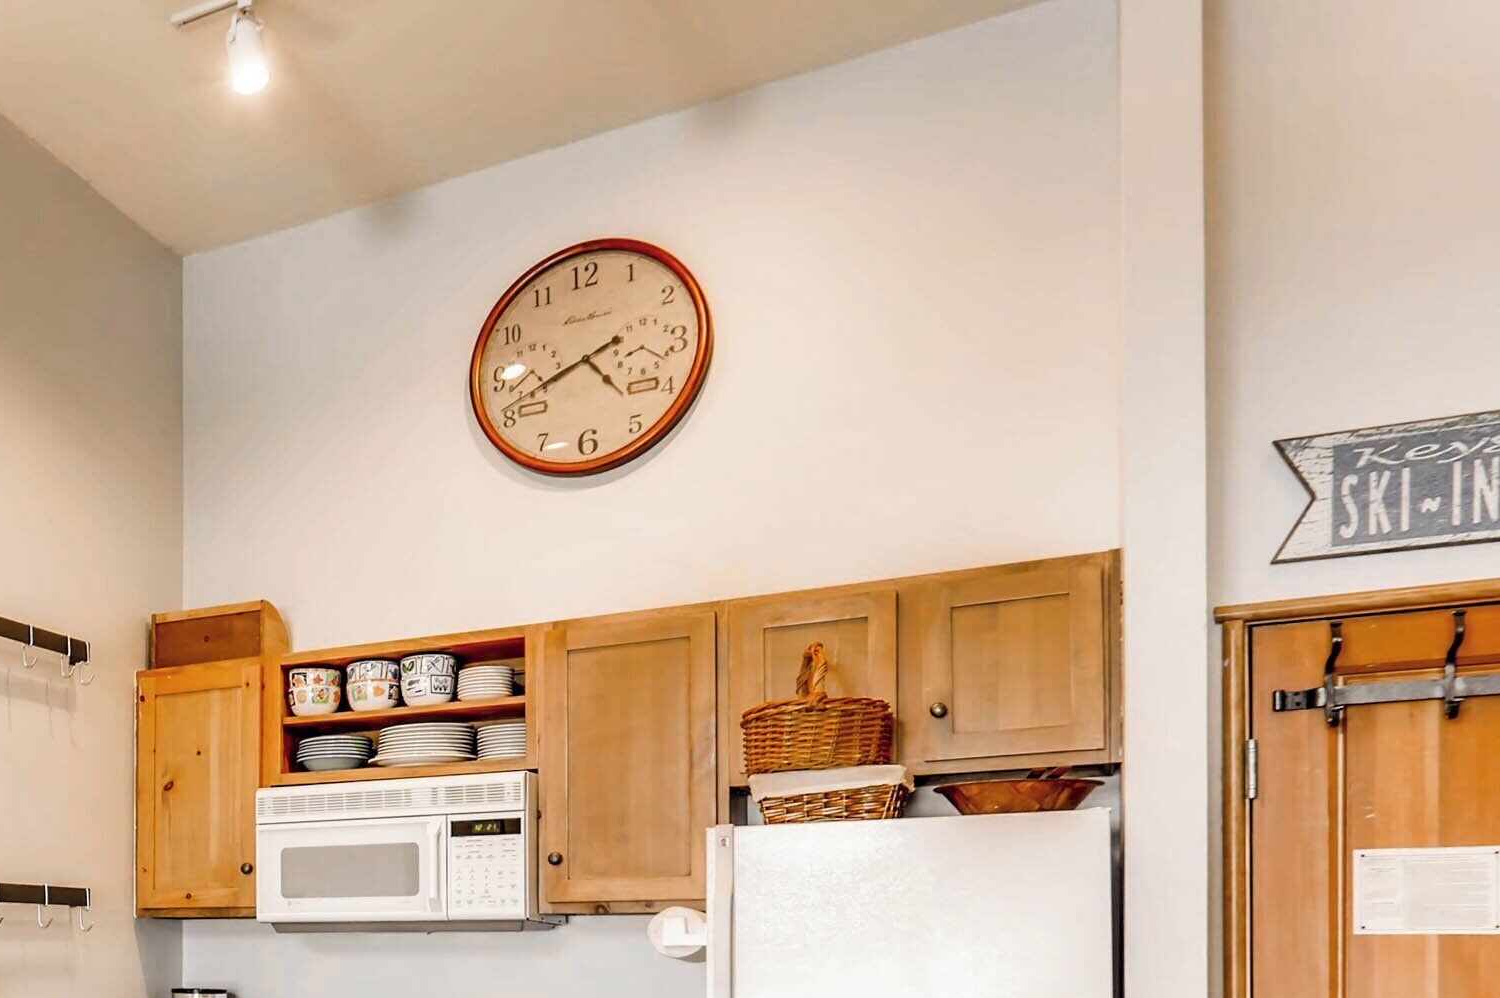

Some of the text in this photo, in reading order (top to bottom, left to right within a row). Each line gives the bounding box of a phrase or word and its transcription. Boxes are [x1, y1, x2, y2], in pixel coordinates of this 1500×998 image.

[571, 262, 598, 290] 12
[627, 263, 636, 282] 1
[533, 286, 552, 308] 11
[661, 285, 675, 305] 2
[503, 323, 522, 346] 10
[669, 325, 688, 353] 3
[493, 366, 506, 393] 9
[660, 376, 676, 394] 4
[503, 409, 516, 429] 8
[628, 414, 642, 434] 5
[537, 433, 549, 452] 7
[577, 429, 599, 455] 6
